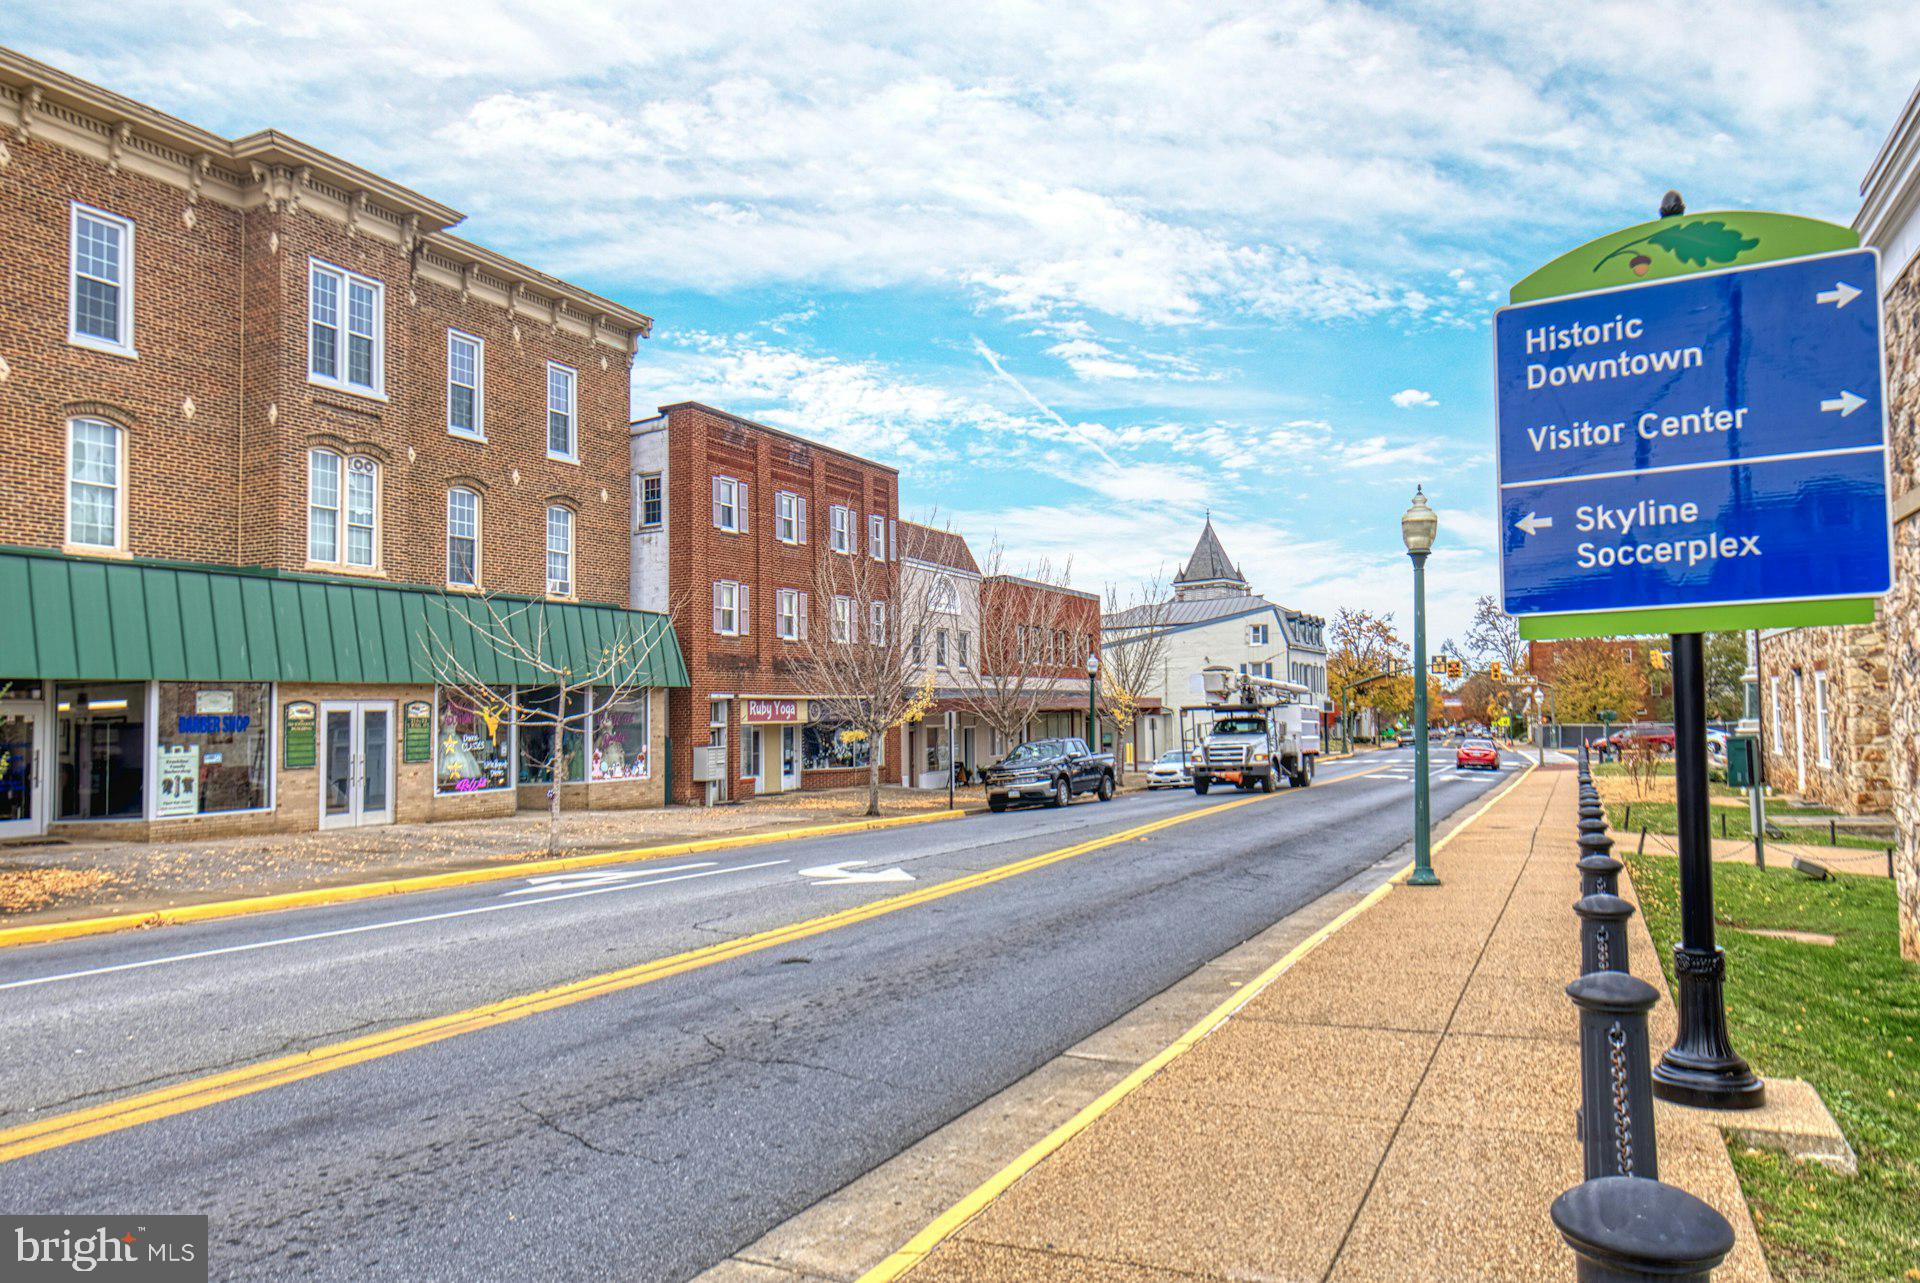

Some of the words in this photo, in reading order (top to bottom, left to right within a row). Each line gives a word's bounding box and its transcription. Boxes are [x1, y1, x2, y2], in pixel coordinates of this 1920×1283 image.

[1525, 315, 1644, 355] Historic
[1526, 346, 1703, 390] Downtown
[1527, 420, 1626, 452] Visitor
[1637, 404, 1750, 440] Center
[1575, 499, 1699, 535] Skyline
[1576, 531, 1763, 569] Soccerplex
[178, 715, 221, 734] BARBER
[222, 715, 250, 733] SHOP
[749, 700, 772, 720] Ruby
[773, 700, 796, 719] Yoga
